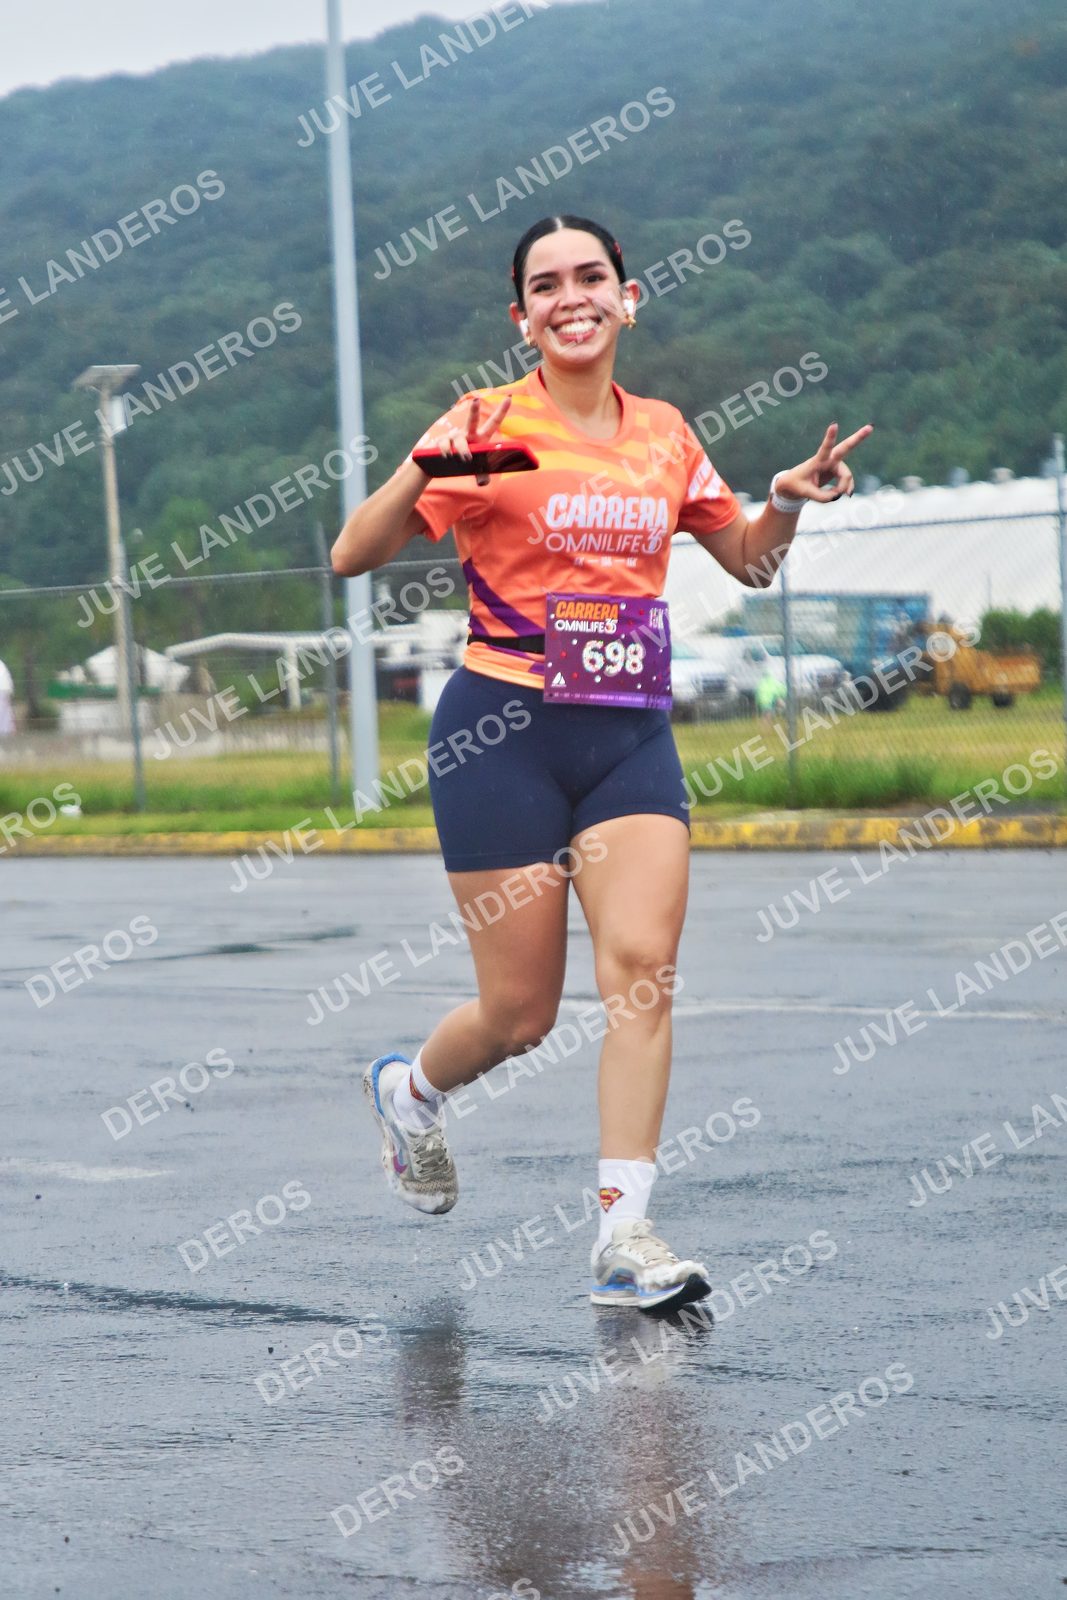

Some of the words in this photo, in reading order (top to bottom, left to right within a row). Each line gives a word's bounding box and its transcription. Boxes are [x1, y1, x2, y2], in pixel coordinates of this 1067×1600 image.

[545, 492, 669, 529] CARRERA
[555, 600, 619, 620] CARRERA
[581, 639, 645, 676] 698
